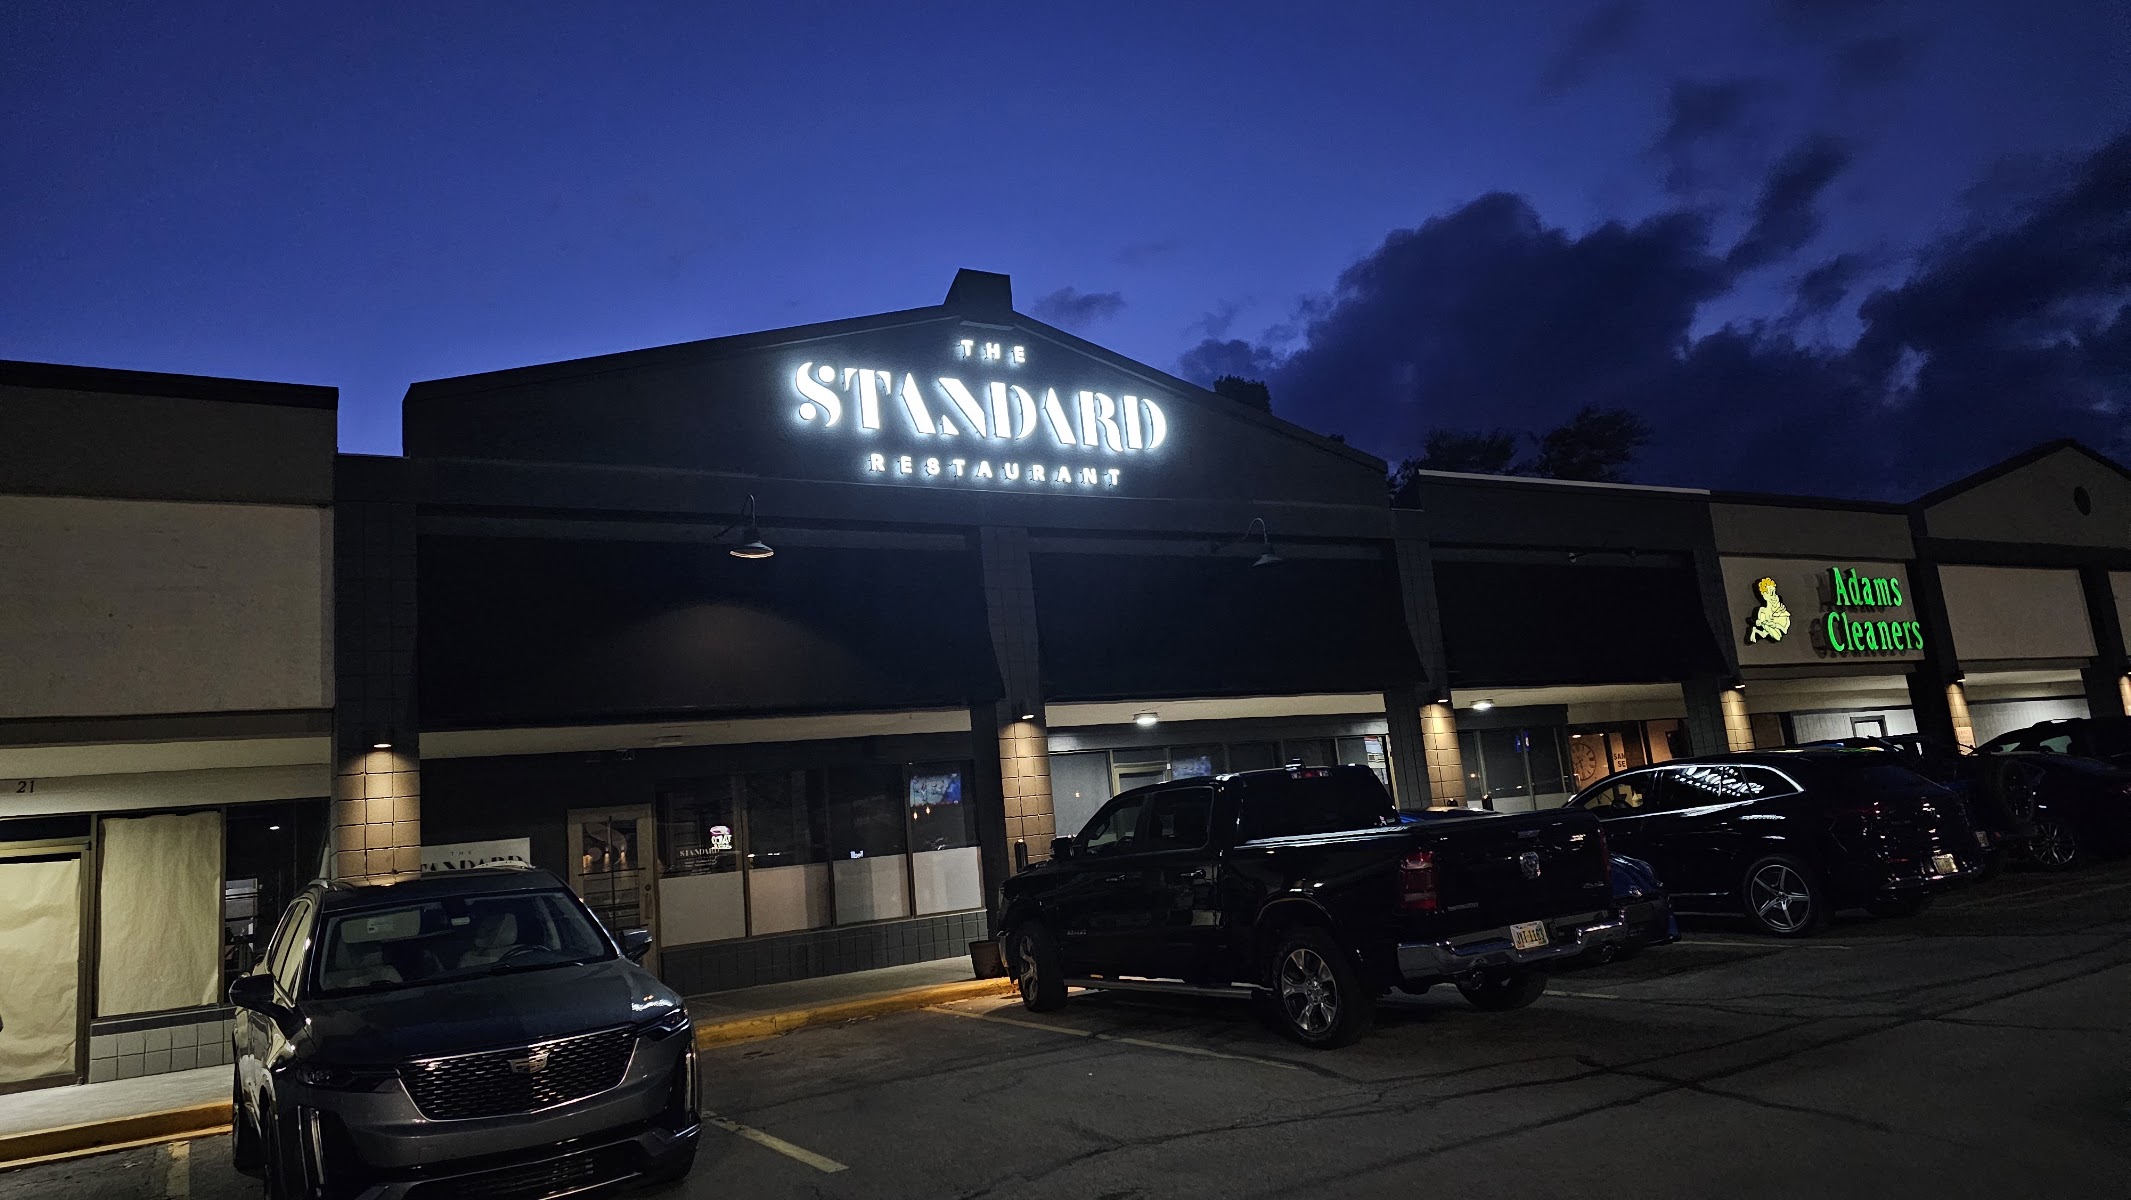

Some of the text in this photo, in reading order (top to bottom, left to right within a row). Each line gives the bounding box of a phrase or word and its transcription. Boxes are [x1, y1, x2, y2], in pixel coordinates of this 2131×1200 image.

[959, 338, 1026, 363] THE
[795, 361, 1168, 452] STANDARD
[869, 453, 1121, 487] RESTAURANT
[1831, 567, 1903, 607] Adams
[1827, 611, 1924, 652] Cleaners
[16, 780, 35, 794] 21
